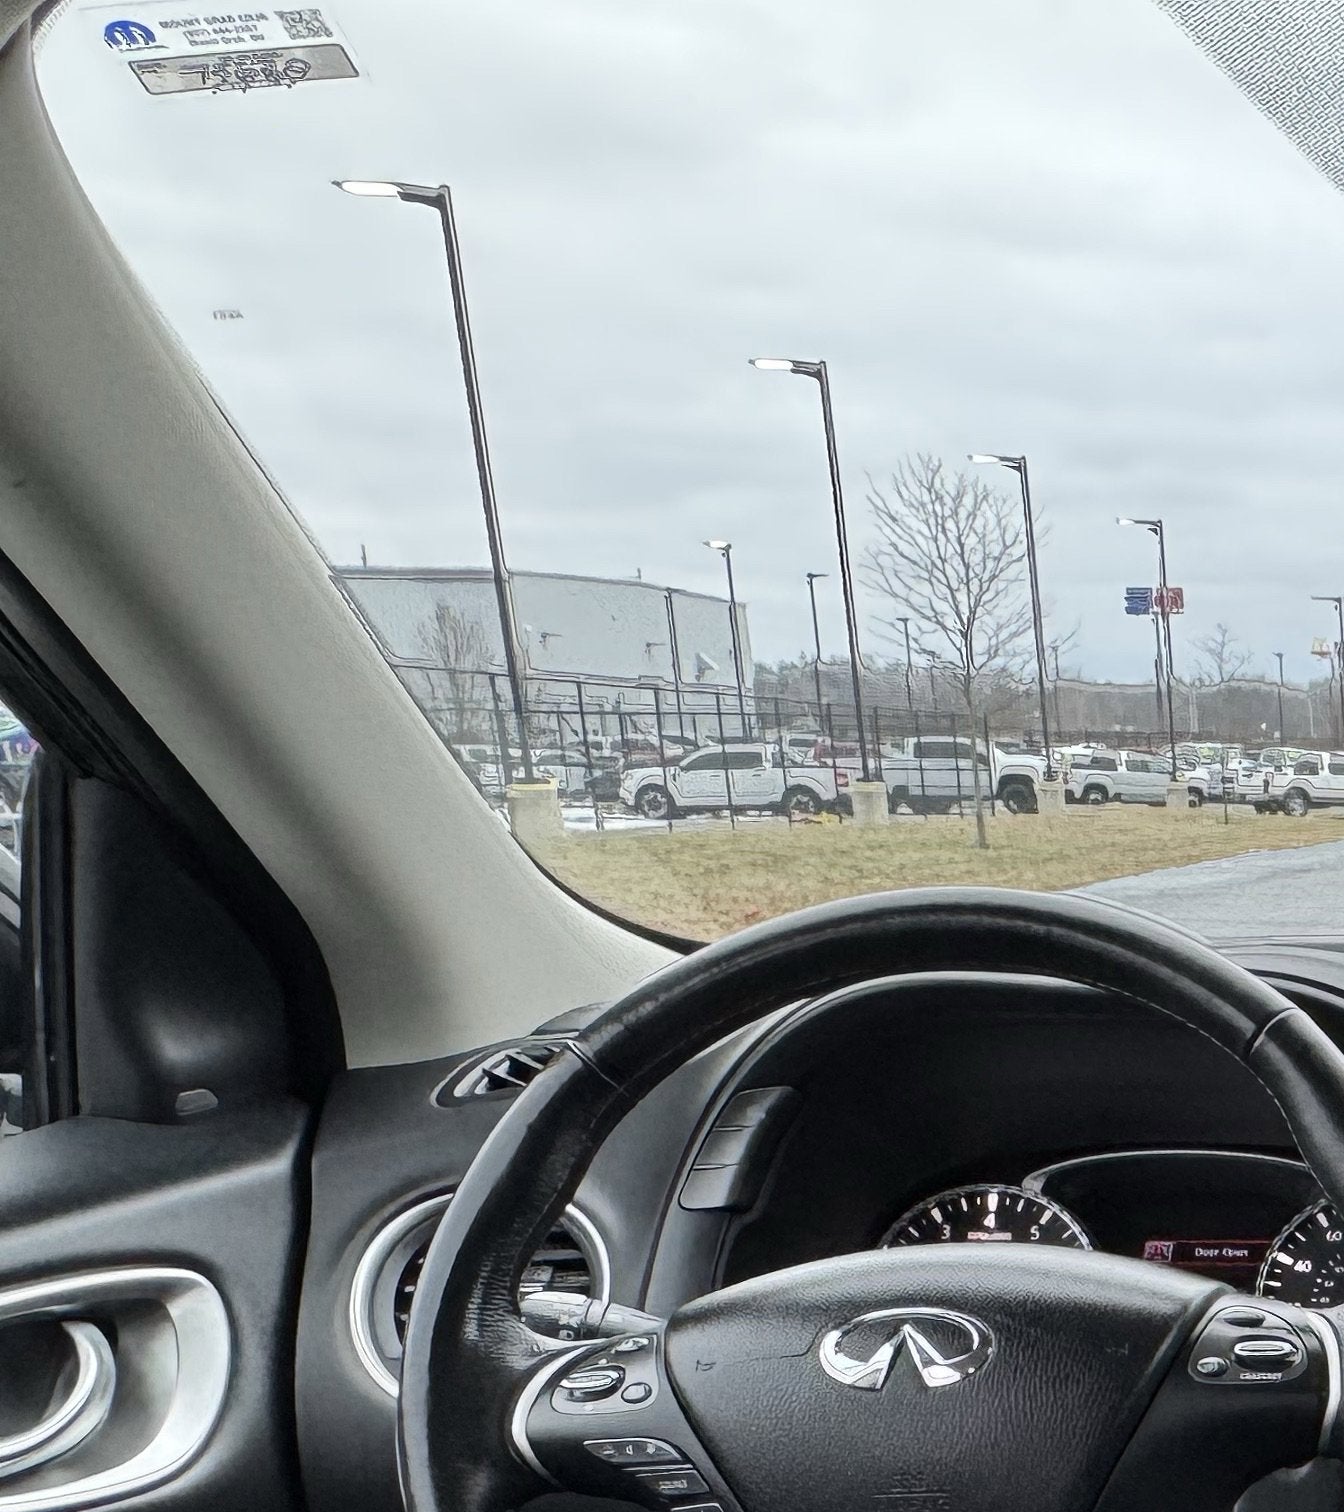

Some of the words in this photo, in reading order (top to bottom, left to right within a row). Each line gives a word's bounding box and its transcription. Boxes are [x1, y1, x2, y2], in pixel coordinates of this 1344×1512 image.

[941, 1224, 951, 1240] 3
[1030, 1225, 1040, 1240] 5
[1326, 1230, 1342, 1242] 60
[1293, 1259, 1312, 1273] 40
